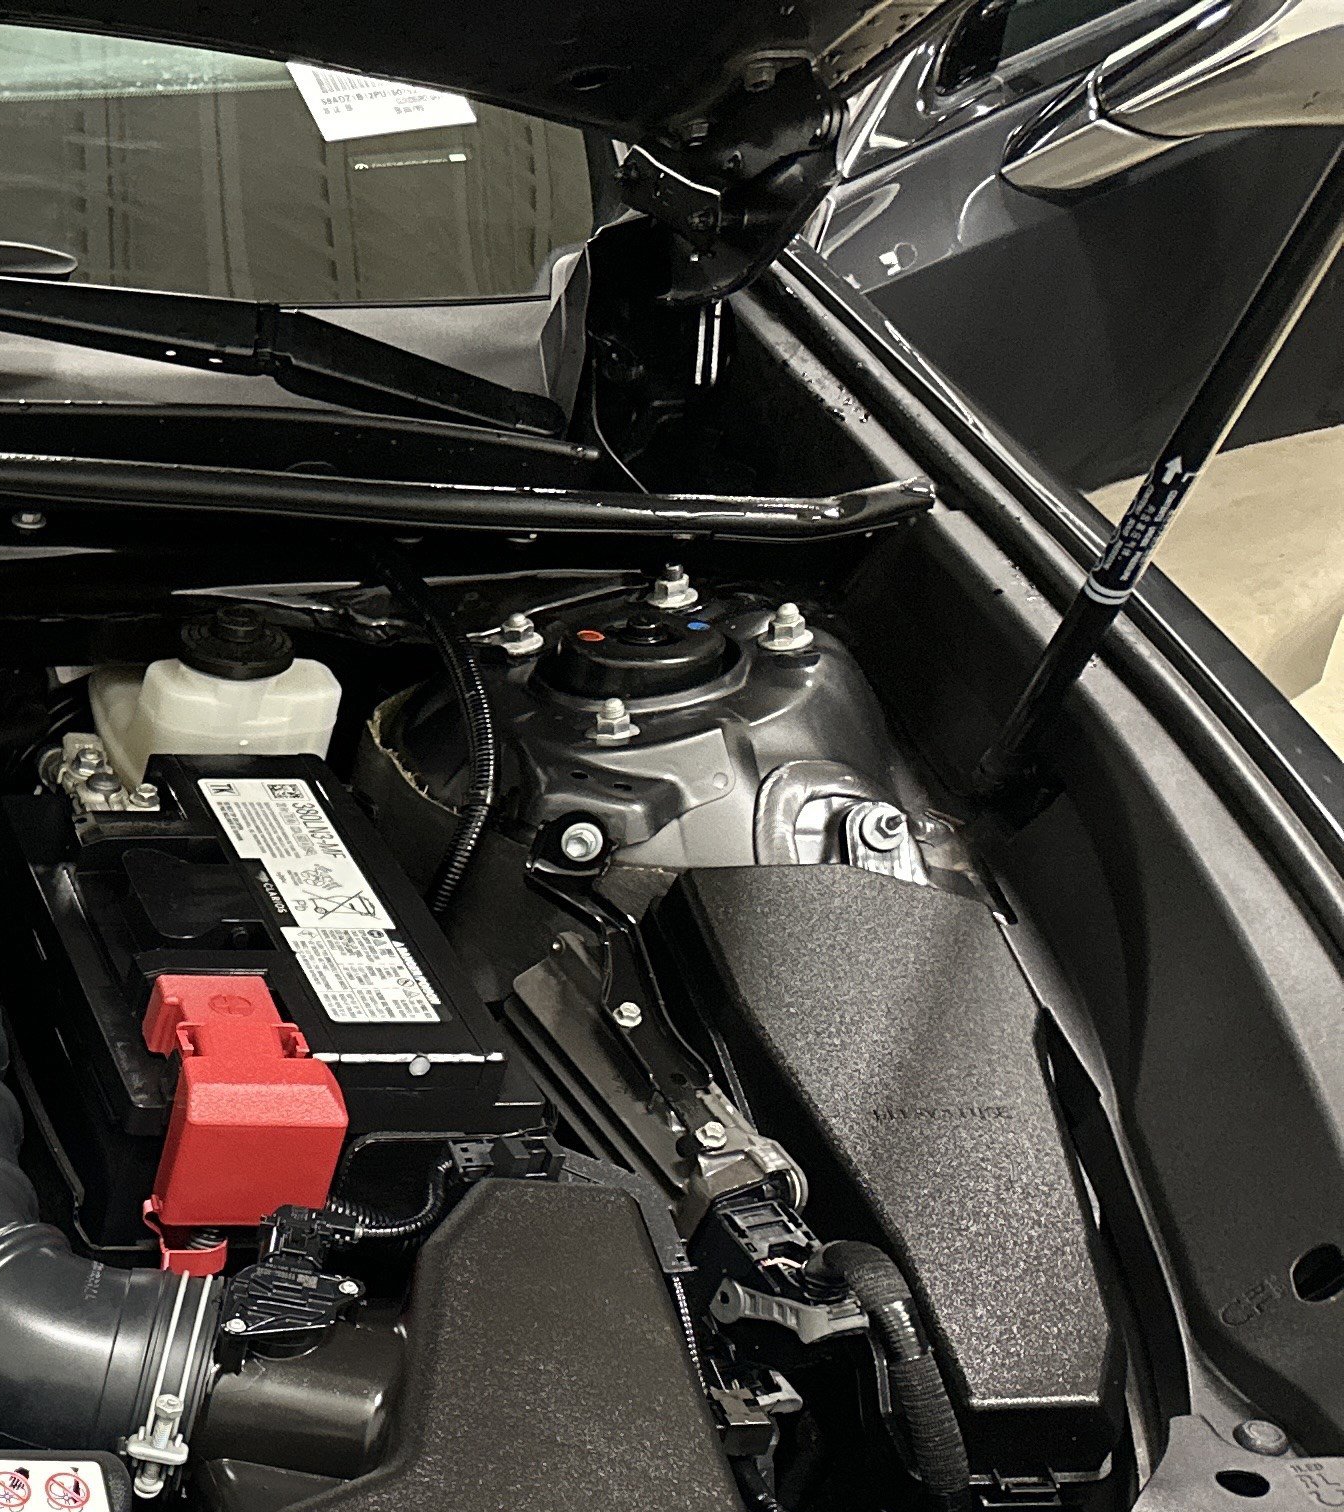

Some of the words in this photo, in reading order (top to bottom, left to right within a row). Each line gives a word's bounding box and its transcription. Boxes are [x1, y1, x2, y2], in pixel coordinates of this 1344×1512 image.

[210, 783, 230, 796] TK
[263, 881, 288, 914] CLARIOS
[294, 899, 309, 912] Pb
